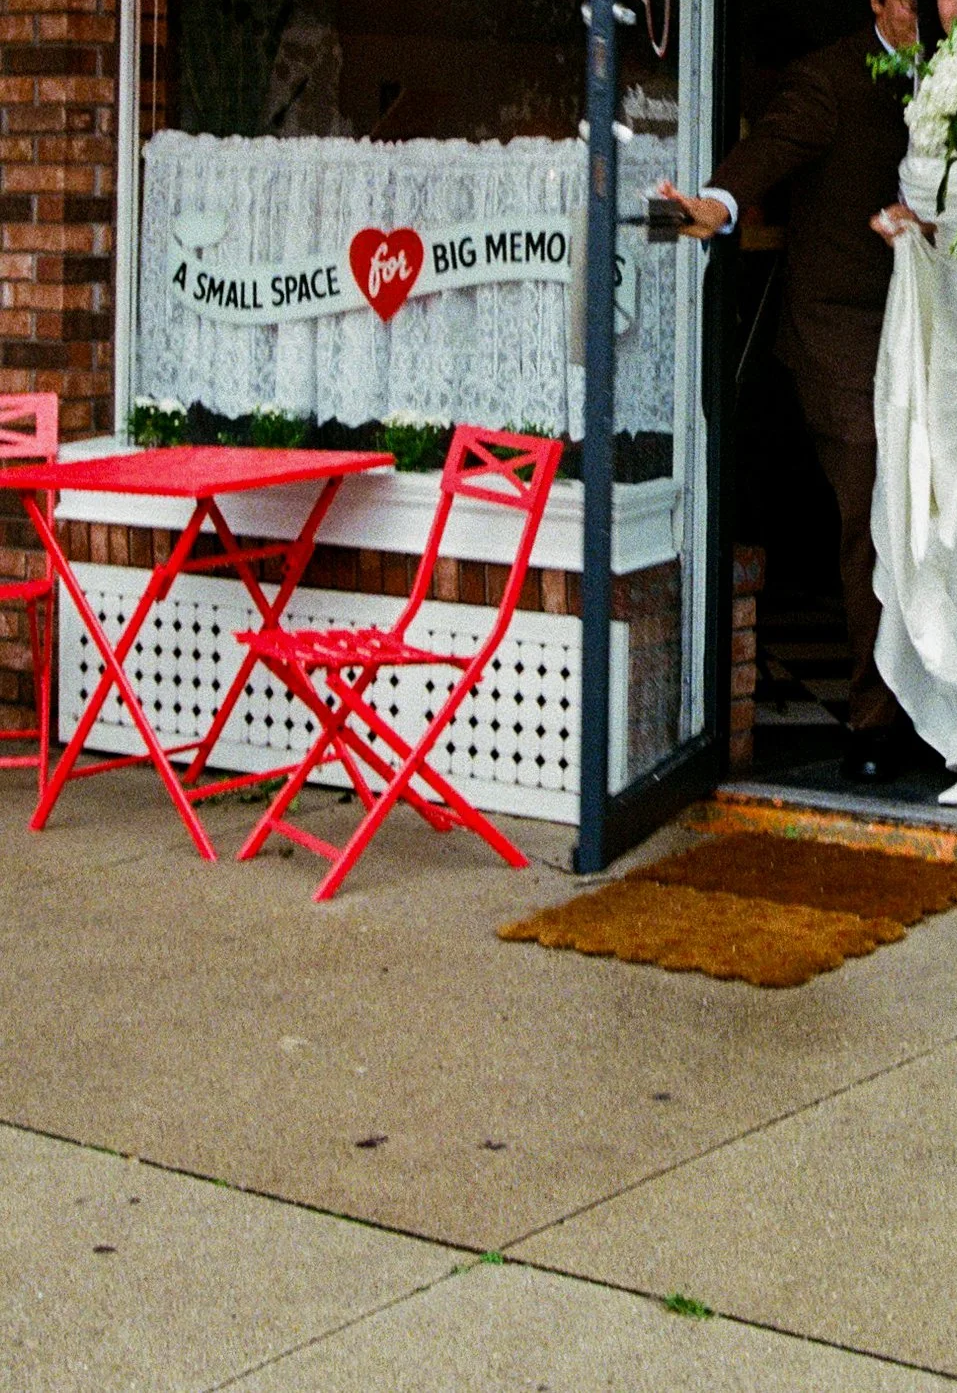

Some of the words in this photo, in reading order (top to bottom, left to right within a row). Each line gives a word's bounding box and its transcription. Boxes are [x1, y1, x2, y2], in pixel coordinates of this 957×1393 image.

[172, 261, 188, 292] A
[193, 272, 263, 309] SMALL
[270, 266, 341, 307] SPACE
[367, 243, 412, 298] for
[432, 237, 477, 274] BIG
